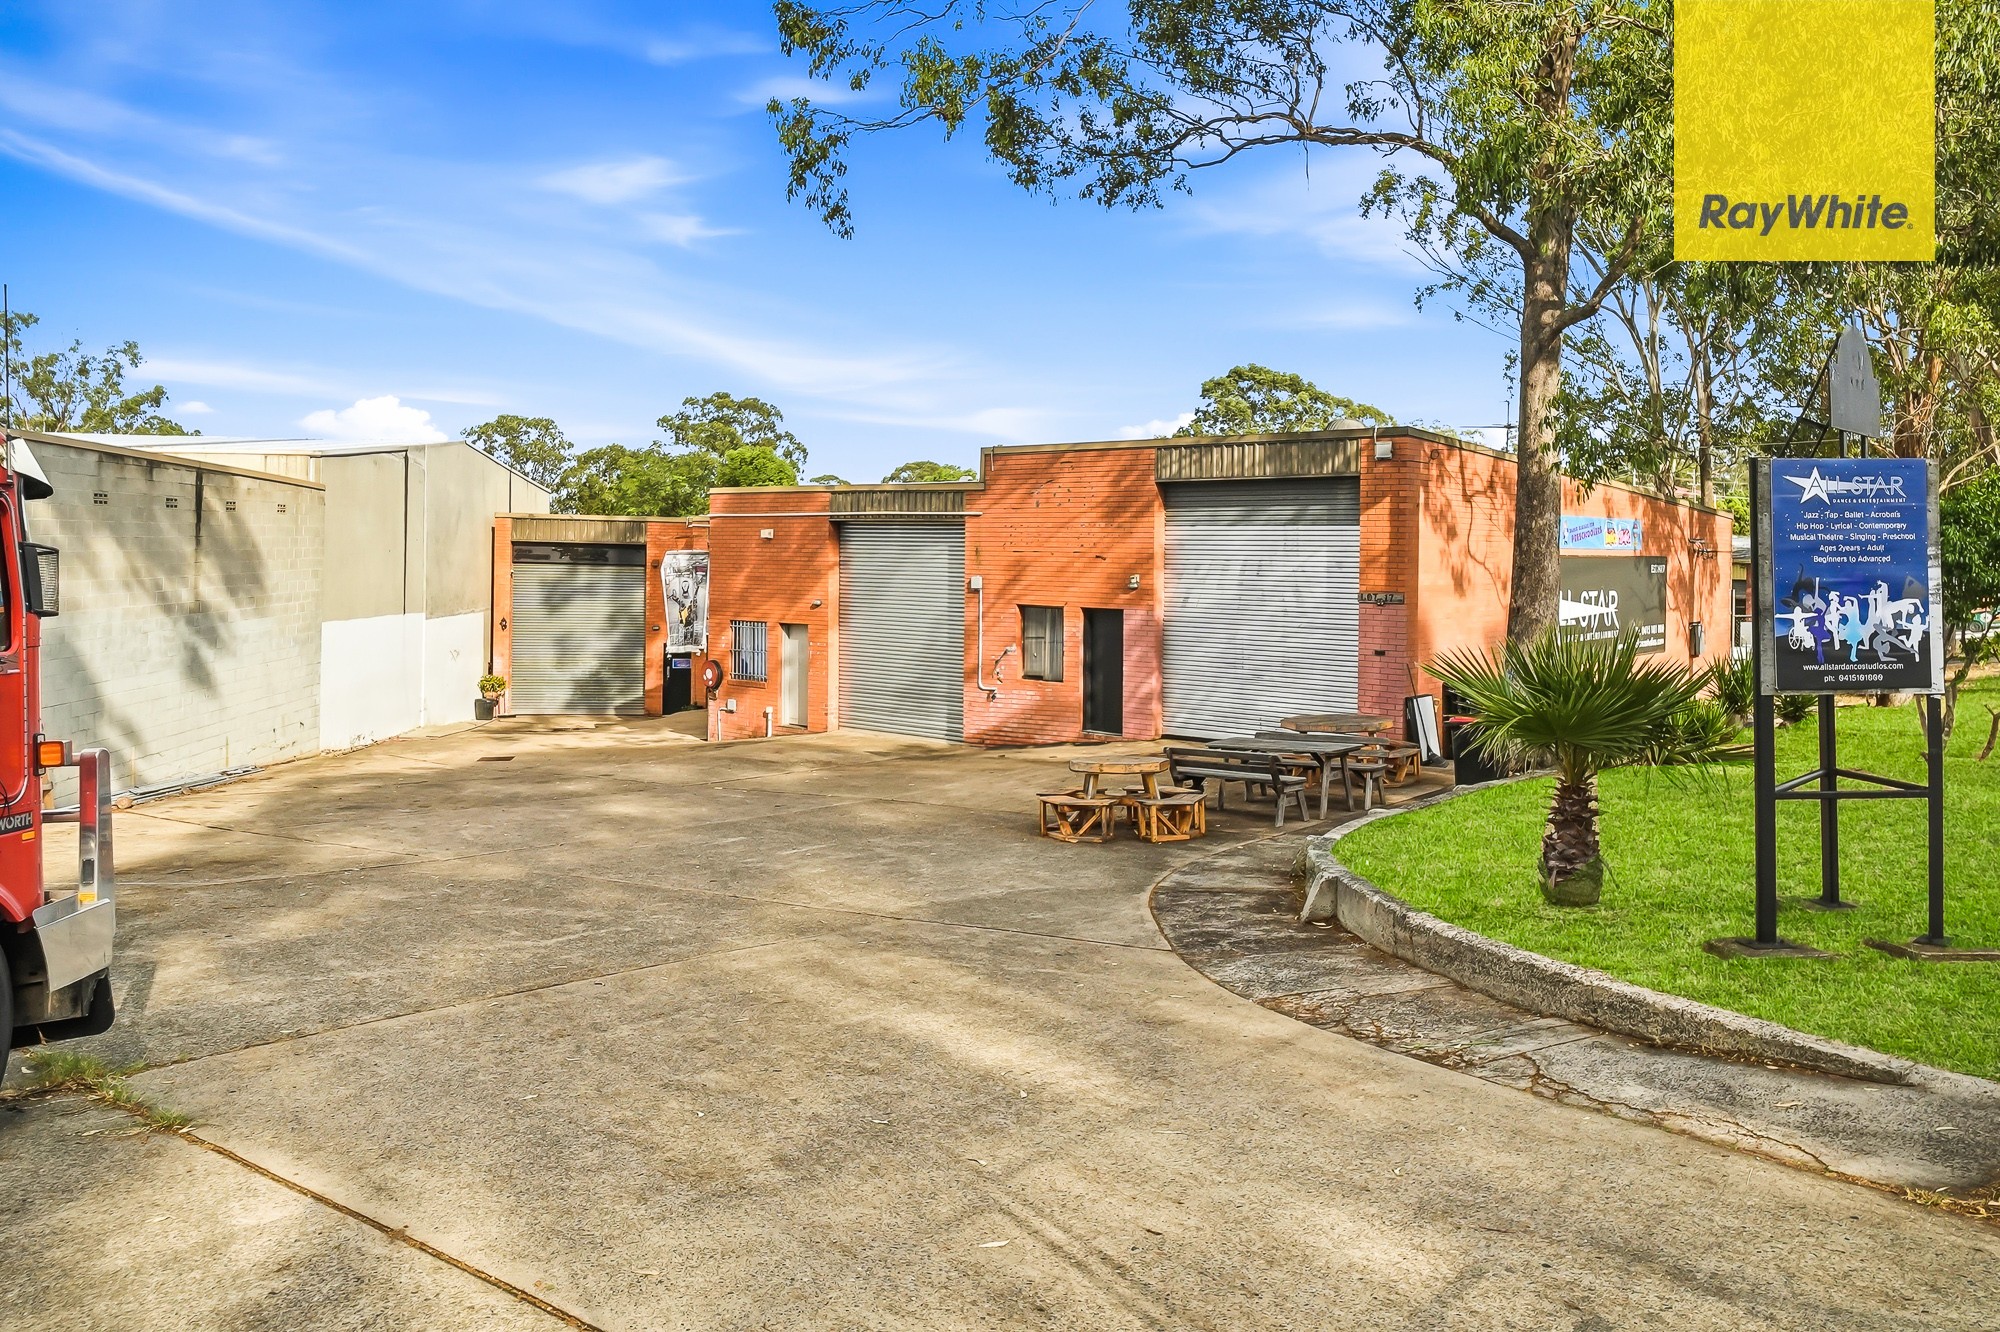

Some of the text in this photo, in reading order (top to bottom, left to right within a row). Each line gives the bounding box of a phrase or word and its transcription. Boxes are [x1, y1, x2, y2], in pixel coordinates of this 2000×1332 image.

[1850, 475, 1908, 499] STAR
[1858, 497, 1907, 505] ENTERTAINMENT
[1803, 511, 1820, 520] Jazz
[1825, 511, 1839, 520] Tap
[1844, 511, 1864, 519] Ballet
[1796, 522, 1809, 531] Hip
[1810, 522, 1825, 531] Hop
[1830, 522, 1853, 530] Lyrical
[1859, 522, 1907, 531] Contemporary
[1790, 533, 1817, 541] Musical
[1817, 533, 1844, 541] Theatre
[1850, 533, 1876, 542] Singing
[1819, 544, 1837, 553] Ages
[1838, 544, 1861, 553] 2years
[1867, 544, 1885, 552] Adult
[1813, 555, 1891, 564] Beginners to Advanced
[1360, 593, 1394, 603] LOT 17
[1559, 589, 1620, 635] LL STAR
[1823, 674, 1836, 683] ph:
